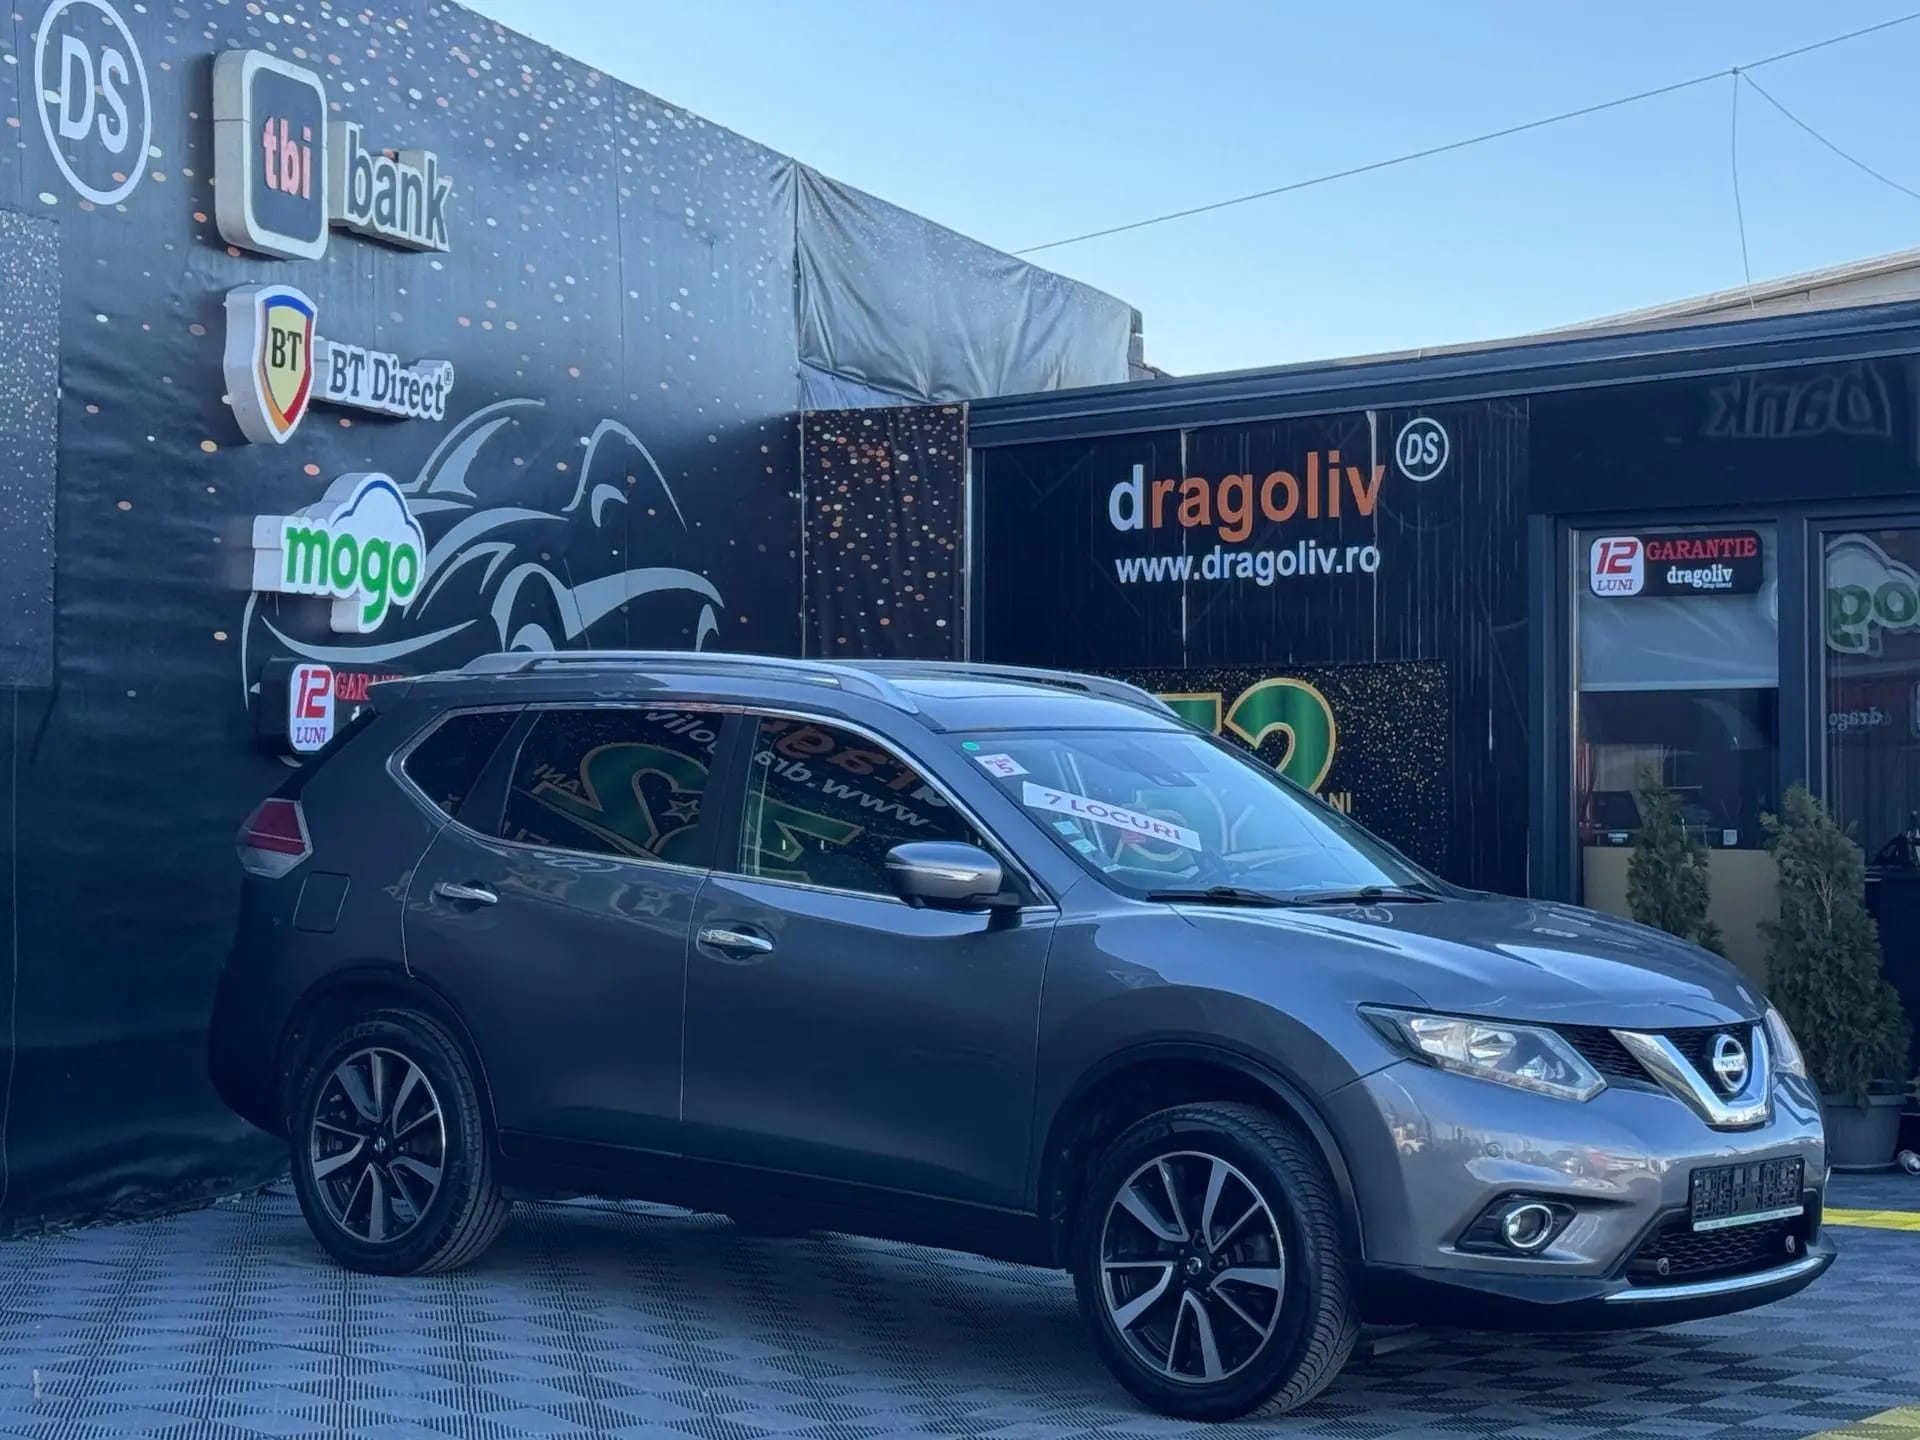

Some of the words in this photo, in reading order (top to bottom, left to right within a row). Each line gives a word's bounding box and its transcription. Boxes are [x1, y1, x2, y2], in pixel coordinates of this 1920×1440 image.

[59, 35, 130, 154] DS
[263, 116, 312, 200] tbi
[347, 128, 449, 246] bank
[271, 326, 303, 372] BT
[330, 348, 366, 397] BT
[1405, 432, 1439, 466] DS
[1108, 450, 1386, 542] dragoliv
[285, 526, 418, 625] mogo
[1114, 539, 1381, 586] www.dragoliv.ro
[1596, 541, 1638, 575] 12
[1646, 537, 1757, 560] GARANTIE
[1667, 564, 1733, 588] dragoliv
[1597, 579, 1633, 592] LUNI
[295, 669, 331, 718] 12
[295, 727, 327, 744] LUNI
[1044, 793, 1062, 805] 7
[1071, 799, 1181, 840] LOCURI
